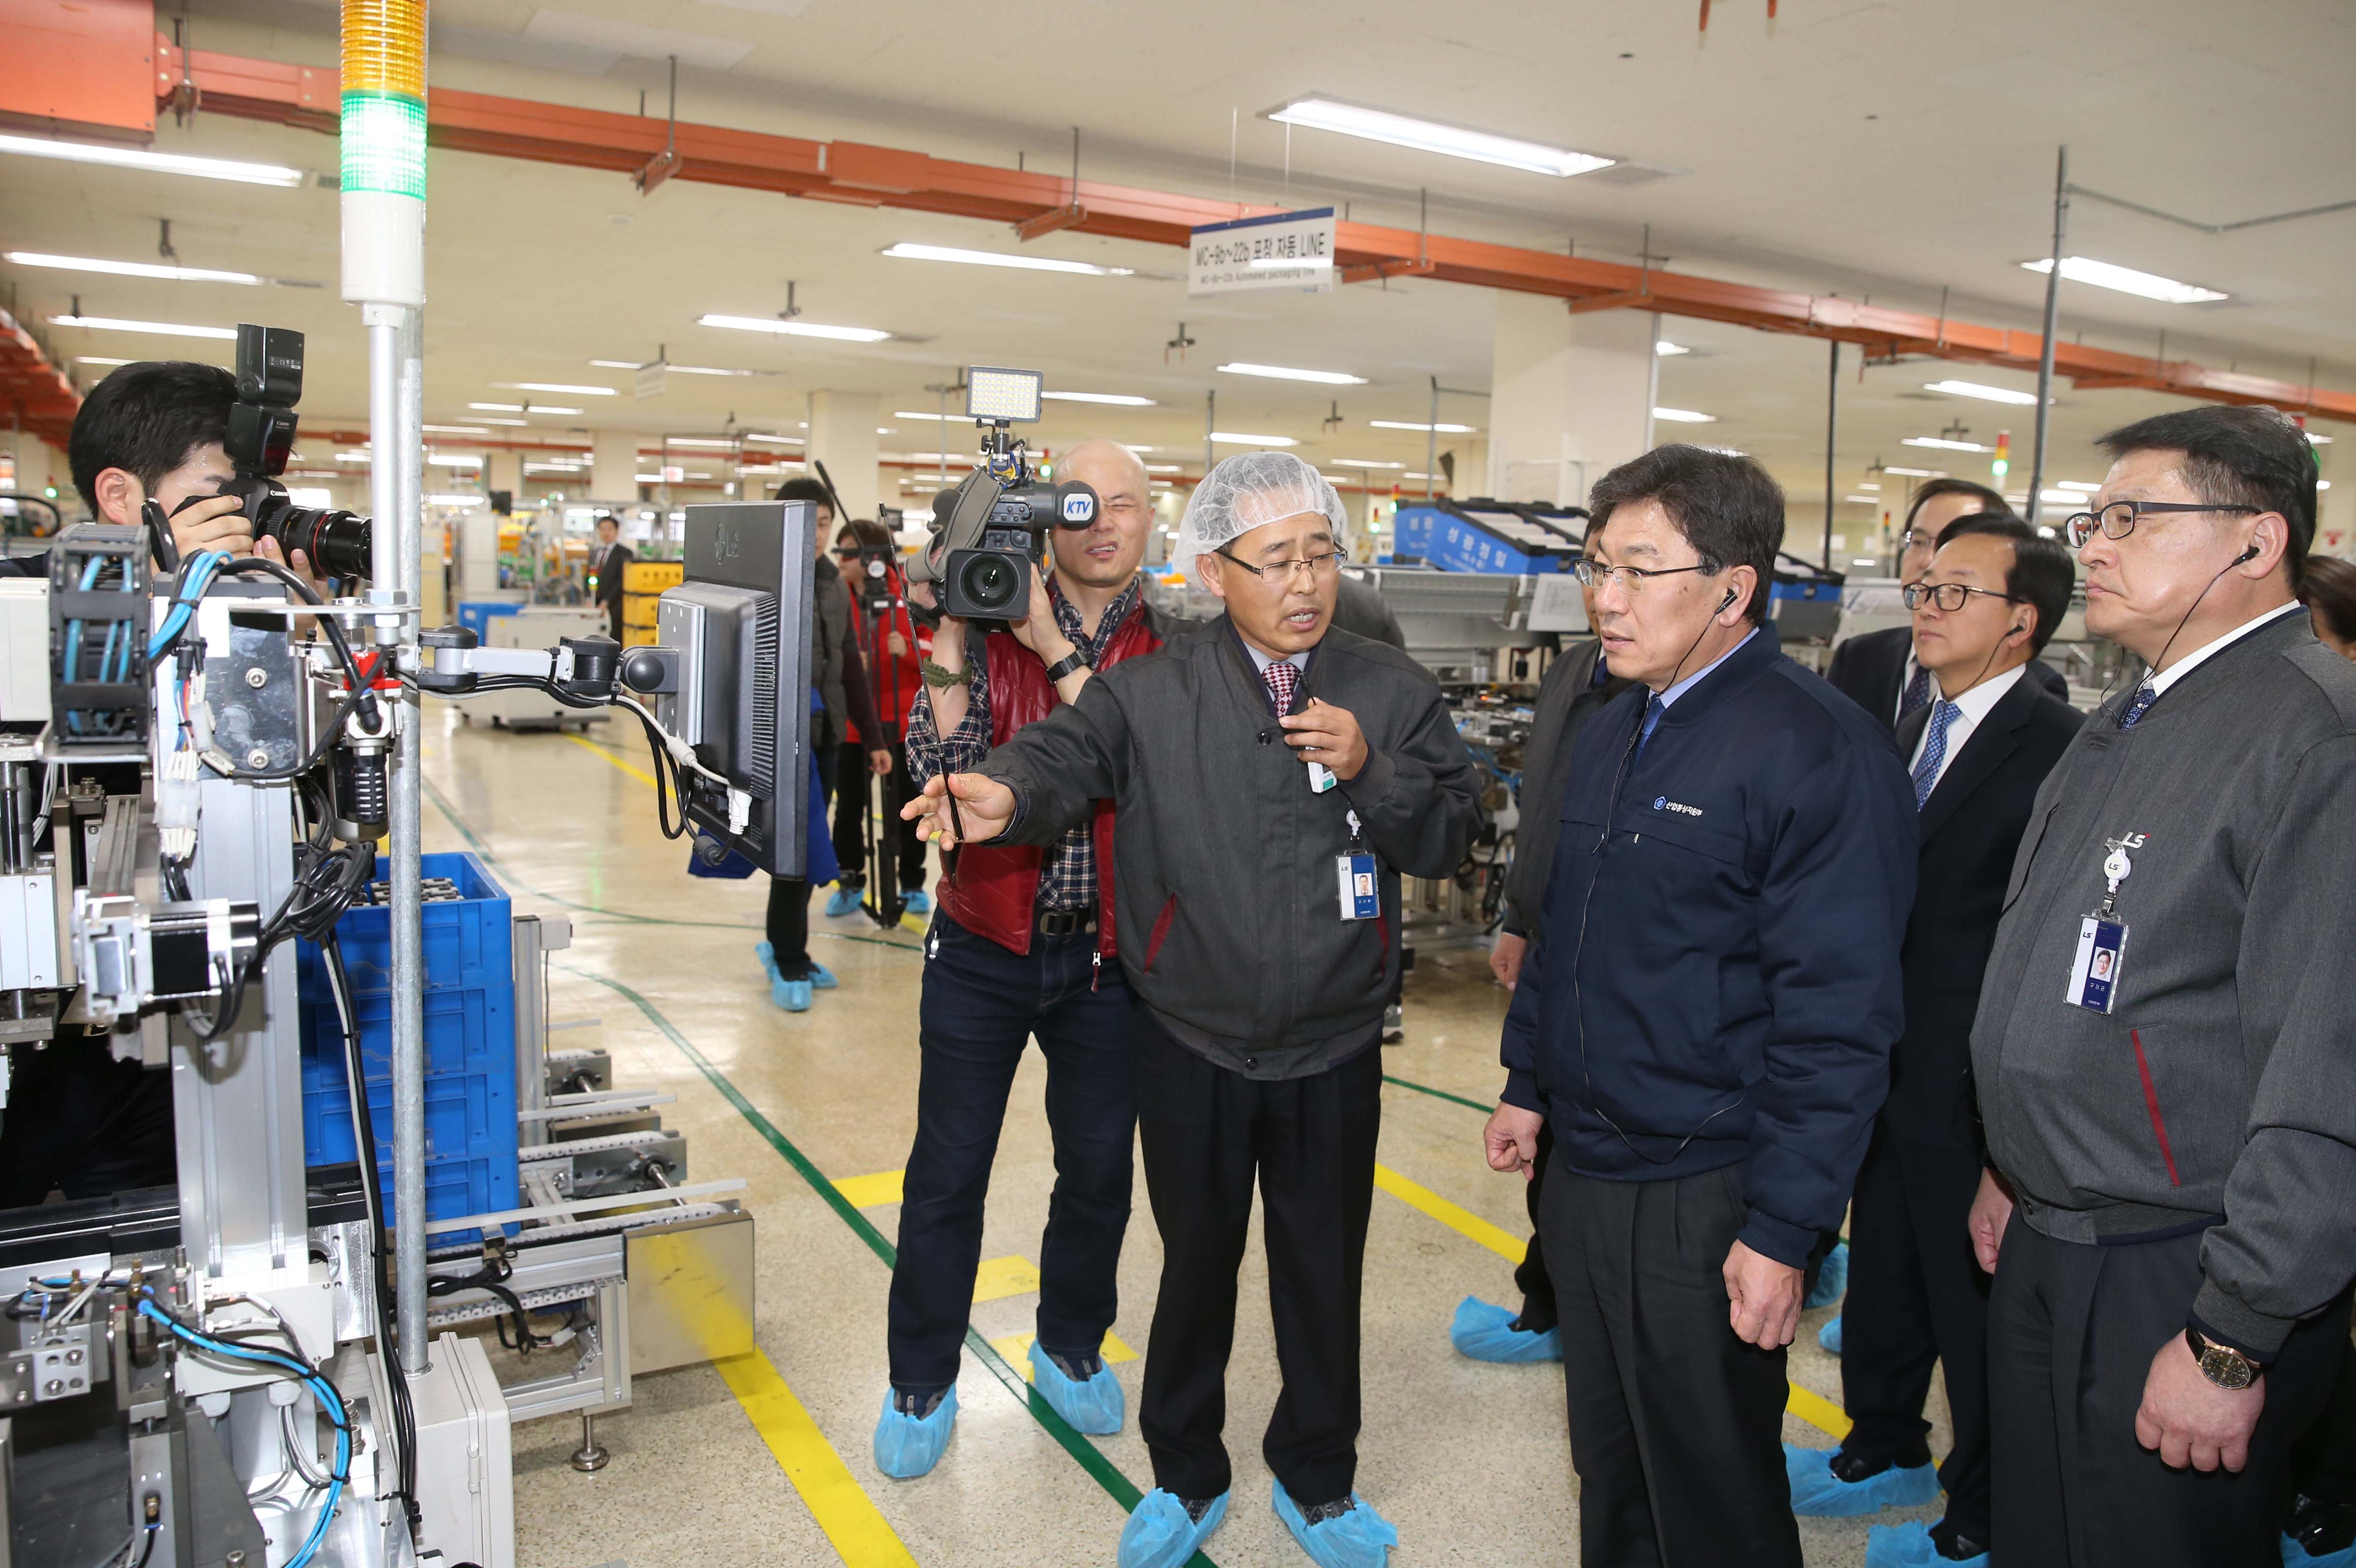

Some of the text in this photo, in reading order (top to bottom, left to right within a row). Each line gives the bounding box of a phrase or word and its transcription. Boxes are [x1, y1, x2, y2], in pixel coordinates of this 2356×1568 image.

[1276, 235, 1296, 259] 자동
[1301, 232, 1325, 256] LINE
[1066, 501, 1092, 514] KTV
[1666, 801, 1703, 817] 산업통상자원부
[2122, 831, 2146, 849] LS
